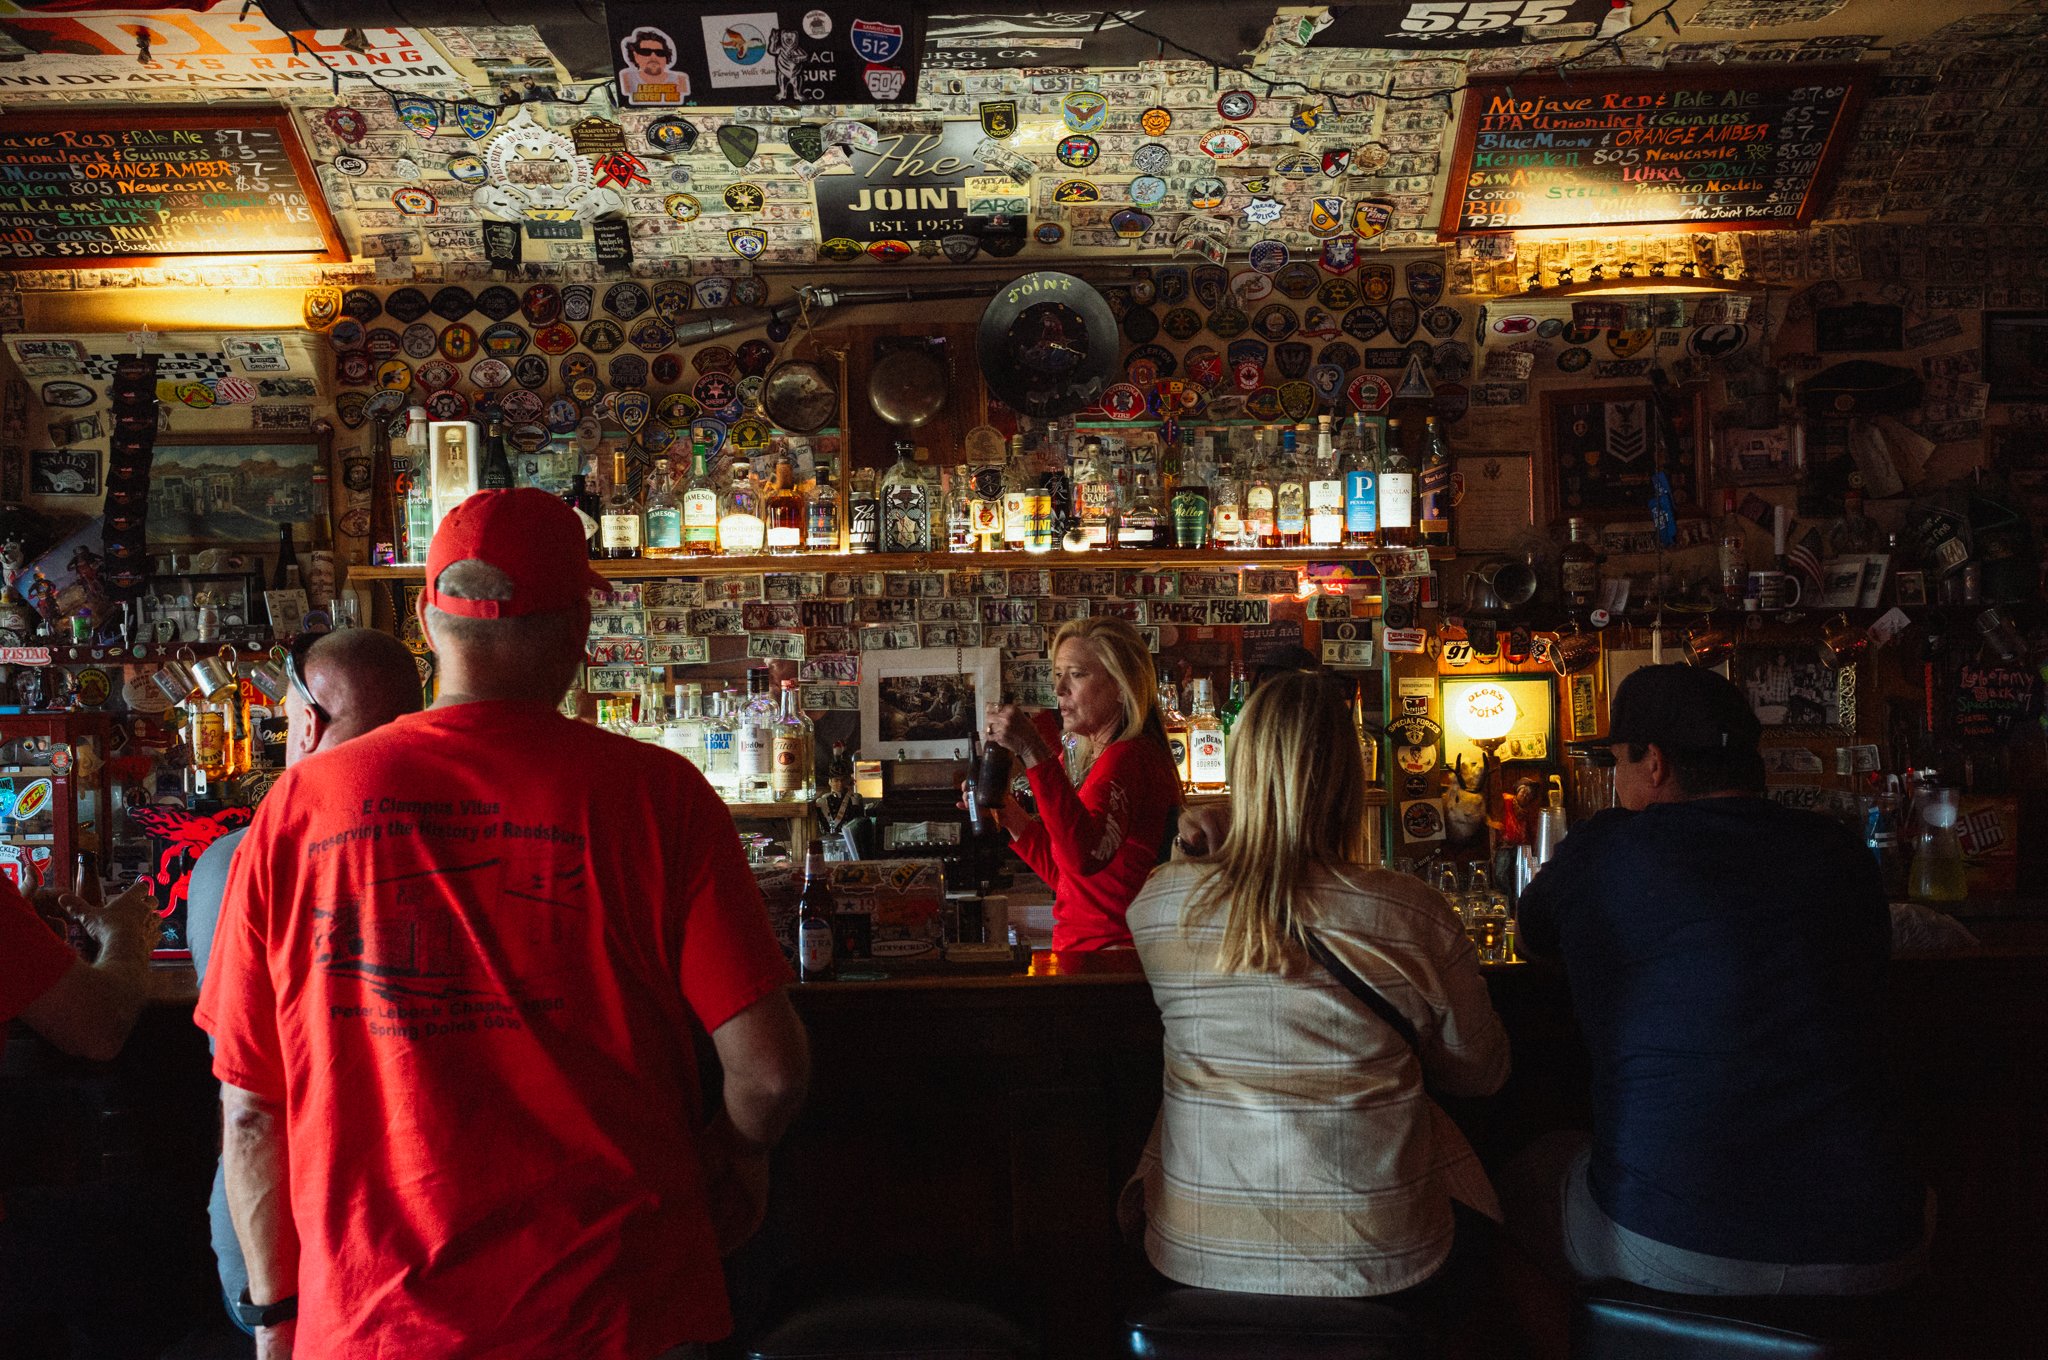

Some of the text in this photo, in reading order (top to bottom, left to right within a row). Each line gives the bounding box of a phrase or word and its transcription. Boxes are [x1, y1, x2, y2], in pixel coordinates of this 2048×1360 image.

[1400, 1, 1577, 33] 555
[863, 24, 895, 34] SAMUELSON
[862, 38, 889, 56] 512
[250, 50, 423, 69] RACING
[637, 84, 677, 93] LEGENDS
[868, 72, 901, 93] 604
[633, 92, 661, 102] NEVER
[1488, 95, 1593, 120] Mojave
[1672, 90, 1715, 108] Pale
[1720, 89, 1761, 107] Ale
[1657, 110, 1750, 126] Guinness
[130, 129, 170, 146] Pale
[172, 129, 204, 145] Ale
[1201, 128, 1235, 147] CORONADO
[1615, 126, 1701, 148] ORANGE
[1698, 123, 1770, 144] AMBER
[123, 147, 211, 163] Guinness
[490, 143, 506, 183] DESERT
[506, 131, 541, 144] DUST
[855, 134, 975, 180] The
[85, 162, 163, 180] ORANGE
[165, 160, 233, 179] AMBER
[611, 164, 627, 177] 64
[726, 184, 760, 198] SHERIFF
[1705, 180, 1763, 193] Modelo
[848, 188, 967, 212] JOINT
[1250, 210, 1279, 220] POLICE
[1367, 210, 1389, 221] FIRE
[1466, 200, 1521, 217] BUD
[1711, 206, 1744, 219] Joint
[58, 210, 152, 226] STELLA
[158, 209, 226, 226] Pacifico
[868, 219, 965, 233] EST. 1955
[732, 230, 761, 239] POLICE
[306, 289, 338, 300] POLICE
[1082, 484, 1107, 493] ELIJAH
[1353, 476, 1373, 499] P
[685, 493, 713, 503] JAMESON
[1082, 493, 1108, 502] CRAIG
[648, 509, 676, 519] JAMESON
[1174, 504, 1204, 518] Weller
[1467, 688, 1505, 703] OLGA'S
[1388, 716, 1441, 734] SPECIAL FORCES
[1194, 734, 1223, 749] JIM BEAM
[1196, 760, 1222, 768] BOURBON
[363, 800, 373, 815] E
[460, 799, 500, 816] Vitus
[308, 823, 383, 859] Preserving
[388, 820, 413, 837] the
[481, 821, 498, 838] of
